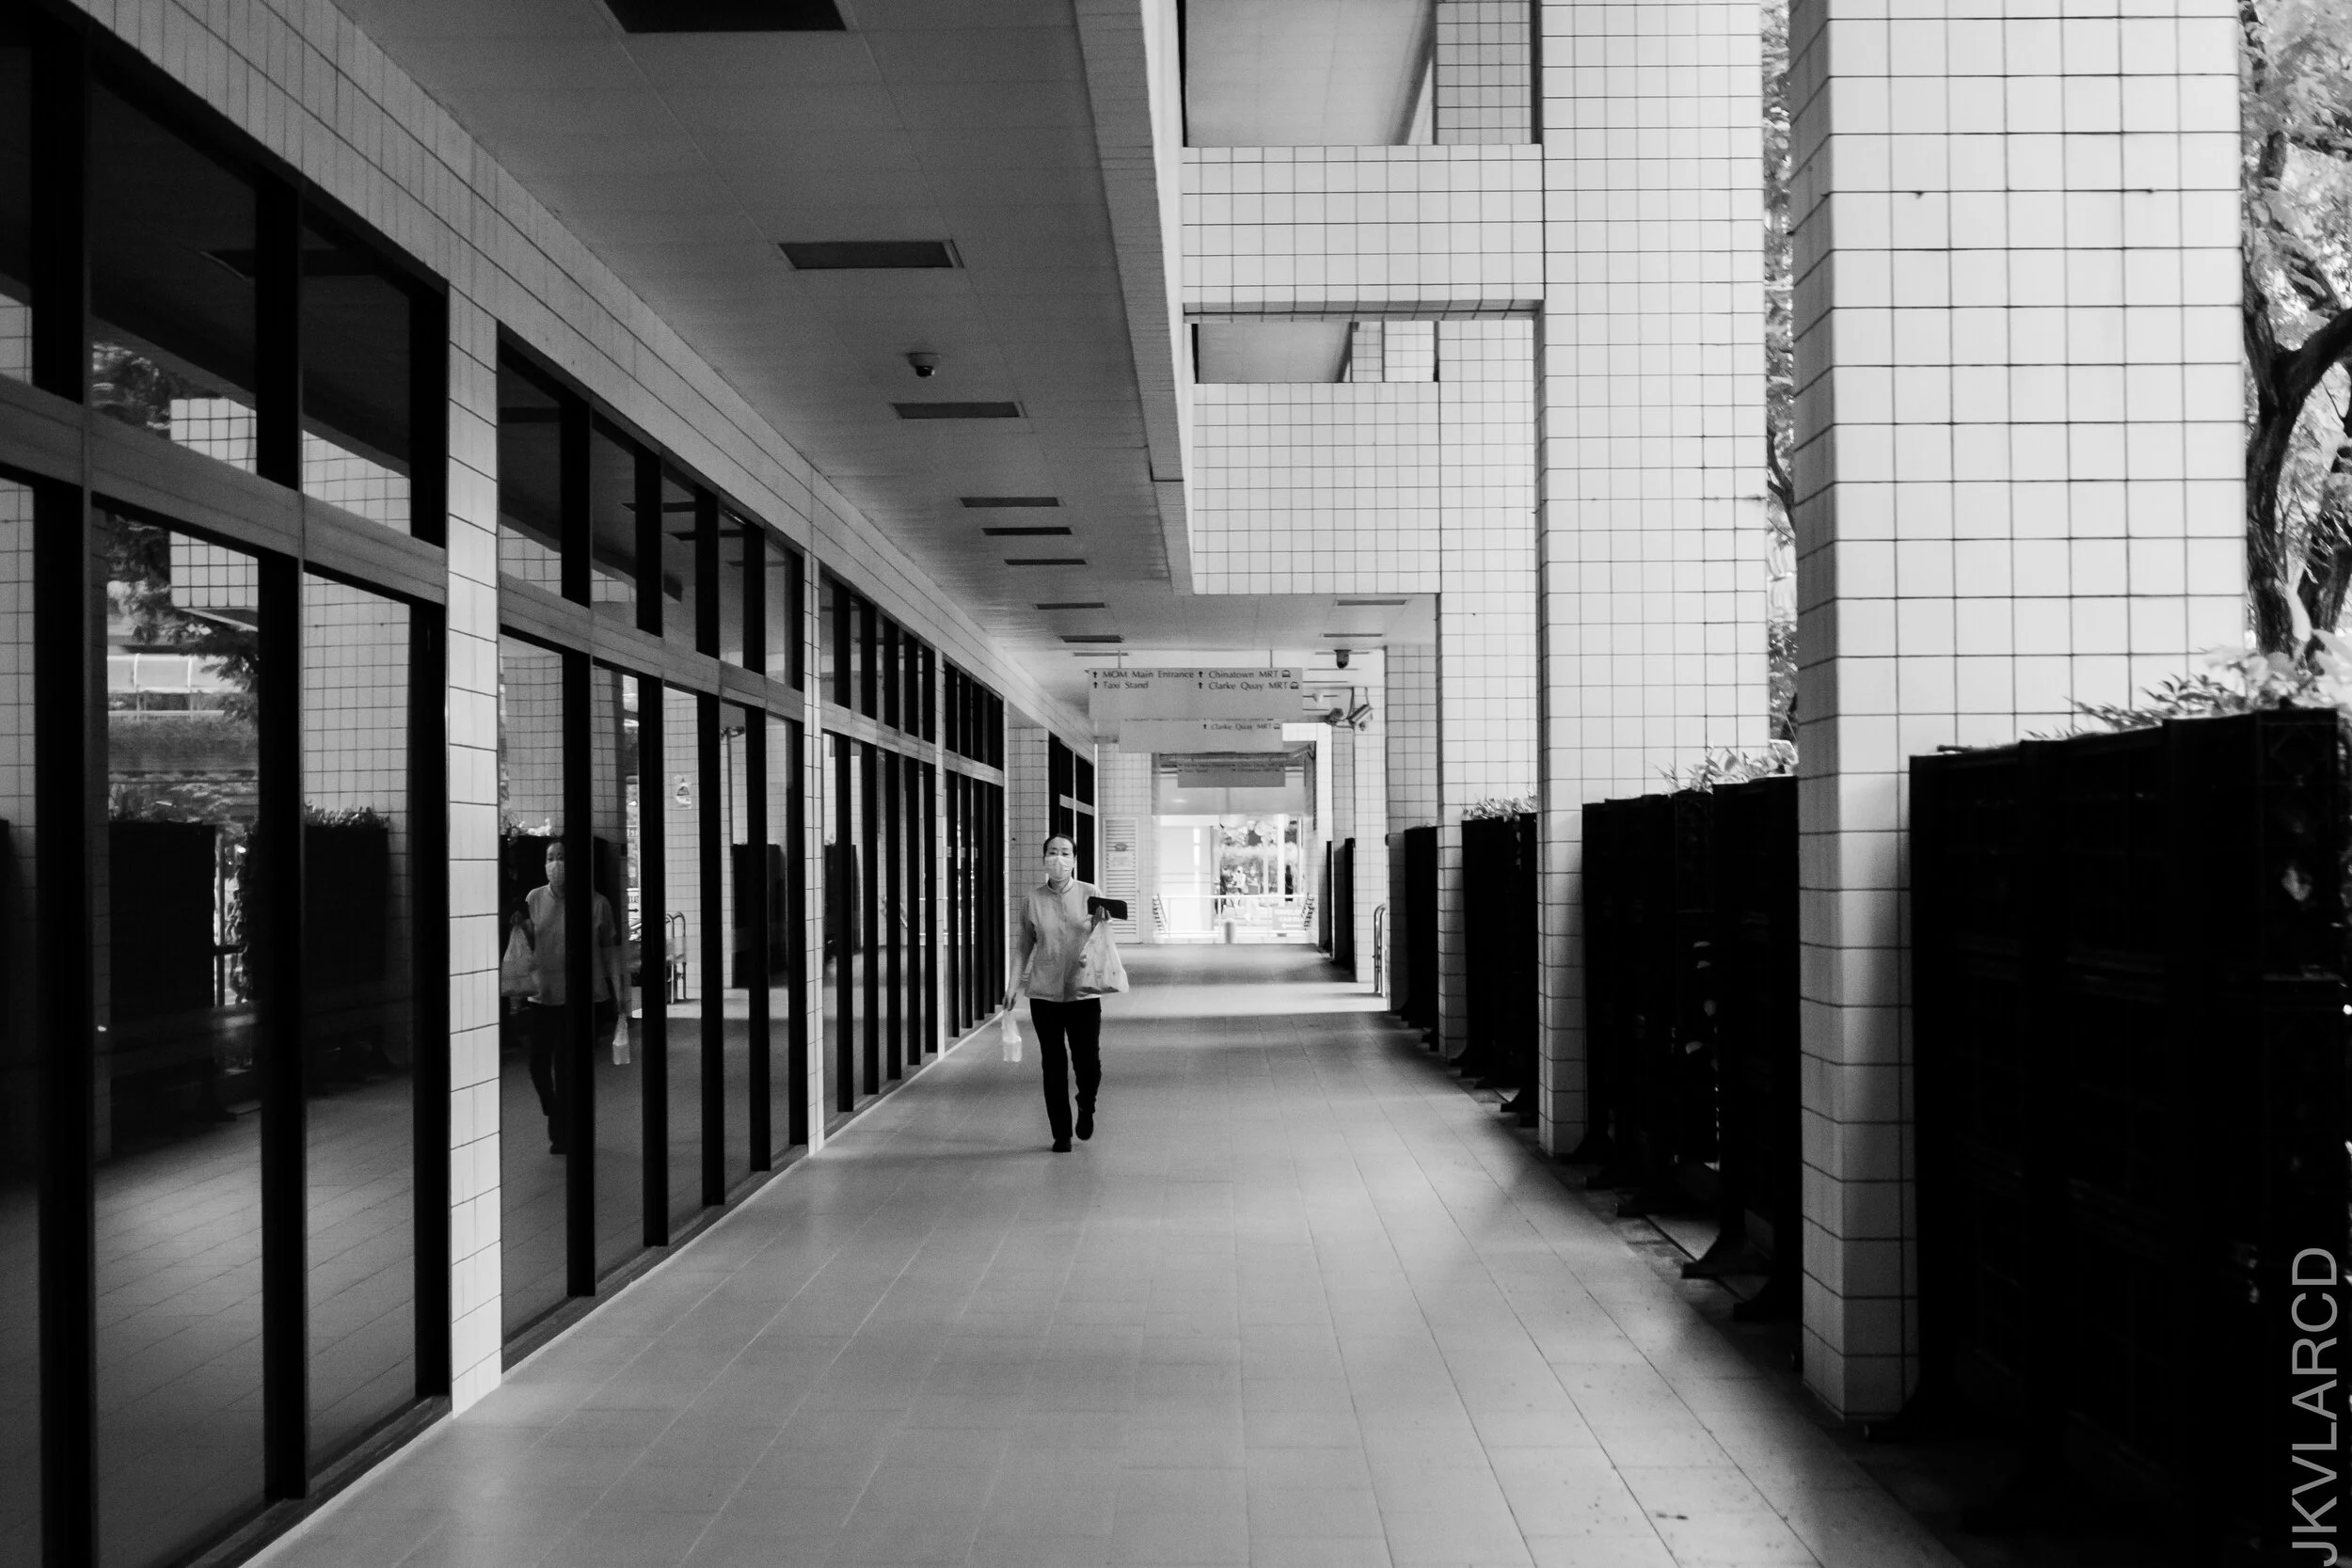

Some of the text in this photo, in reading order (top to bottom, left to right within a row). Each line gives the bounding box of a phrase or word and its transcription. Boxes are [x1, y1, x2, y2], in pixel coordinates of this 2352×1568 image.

[1103, 670, 1195, 678] MOM Main Entrance
[1208, 670, 1279, 678] Chinatown MRT
[1103, 681, 1149, 689] Taxi Stand
[1208, 681, 1288, 691] Clarke Quay MRT
